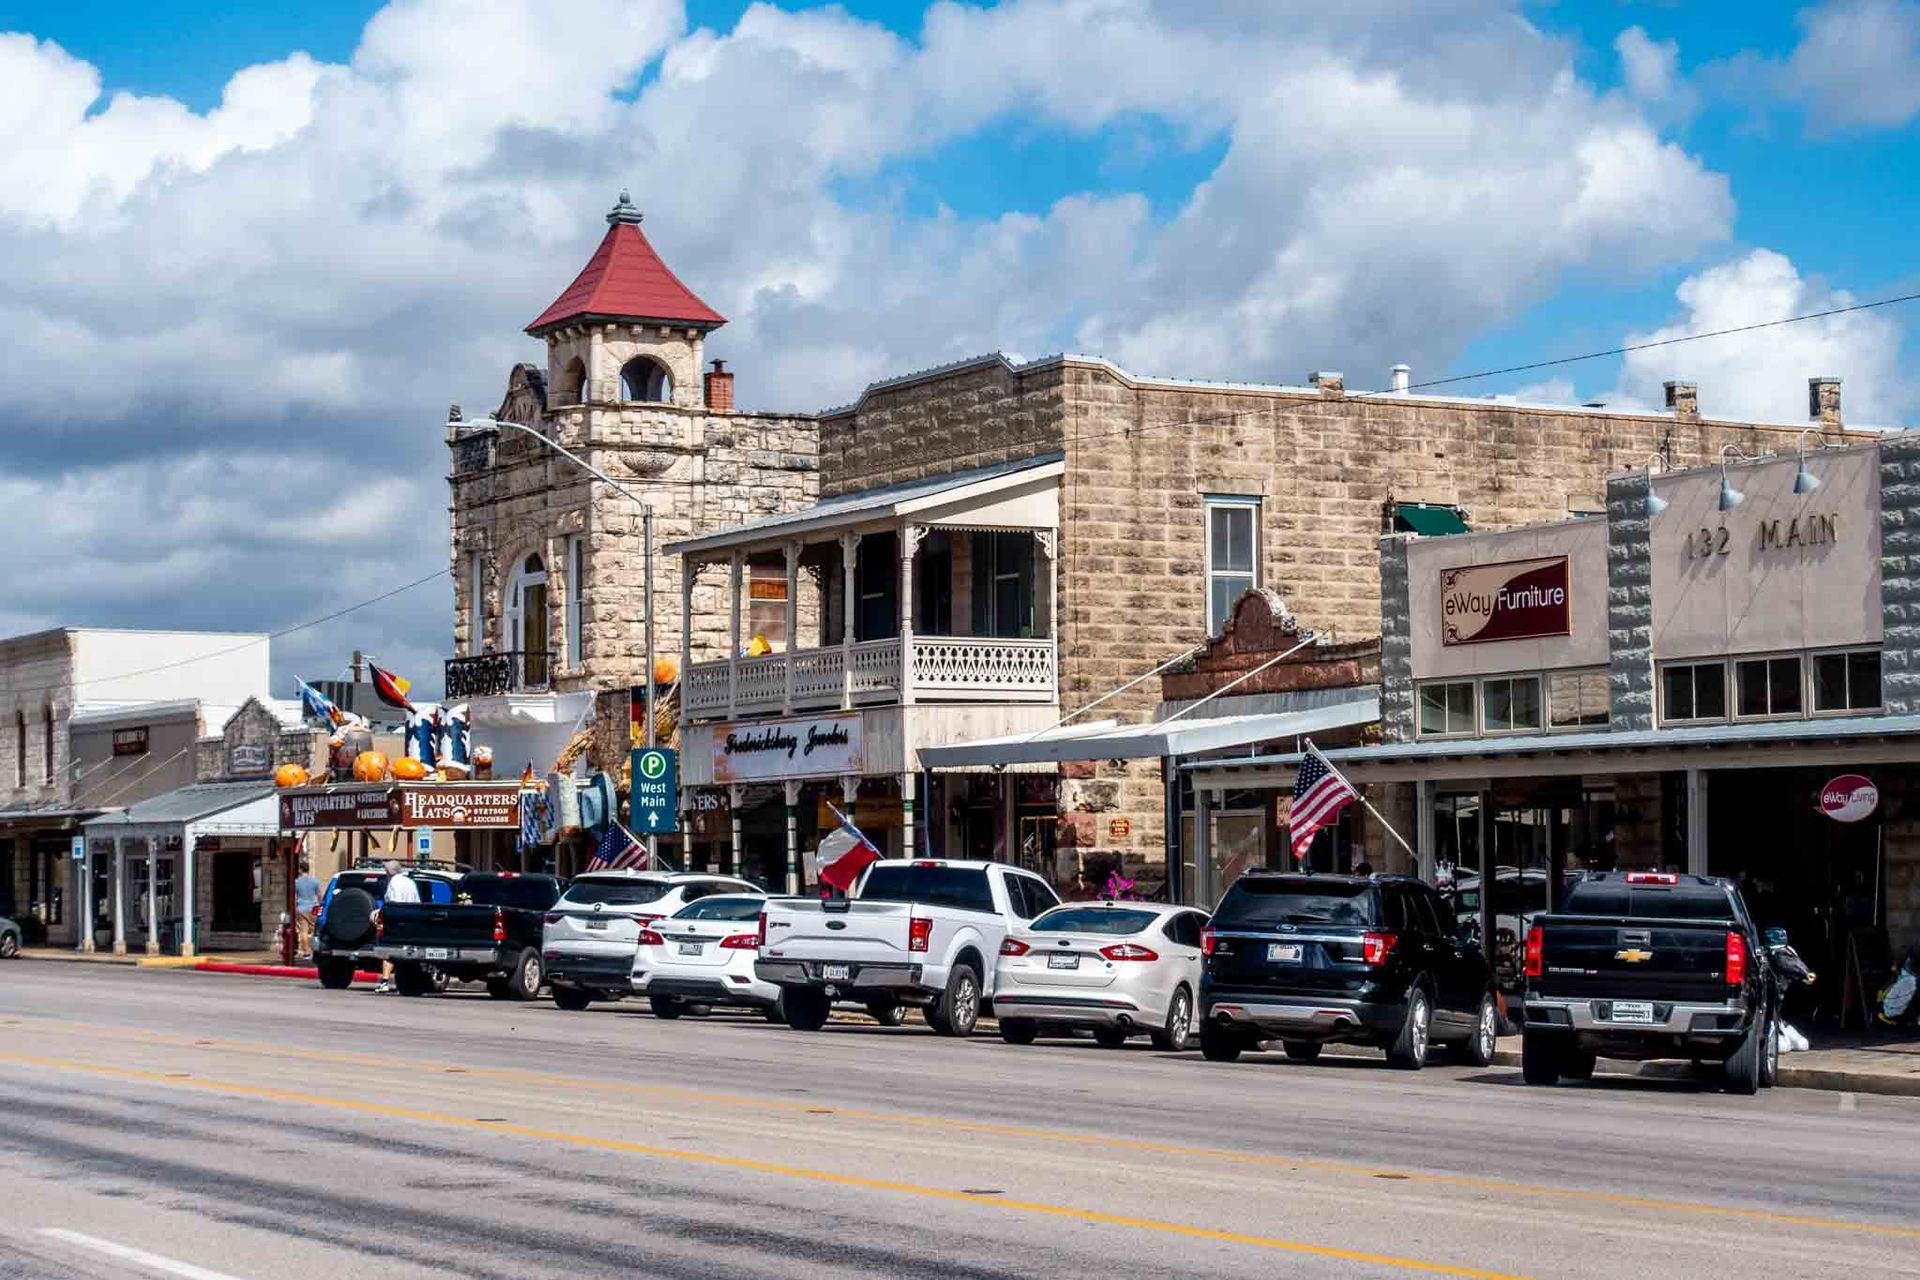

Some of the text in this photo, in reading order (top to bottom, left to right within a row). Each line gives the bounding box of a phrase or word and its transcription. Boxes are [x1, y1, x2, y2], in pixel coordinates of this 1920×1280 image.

[1686, 513, 1839, 560] 132 MAIN
[1446, 585, 1565, 616] eWay Furniture
[641, 783, 666, 793] West
[404, 792, 518, 806] HEADQUARTERS
[641, 796, 666, 807] Main
[411, 803, 451, 819] HATS
